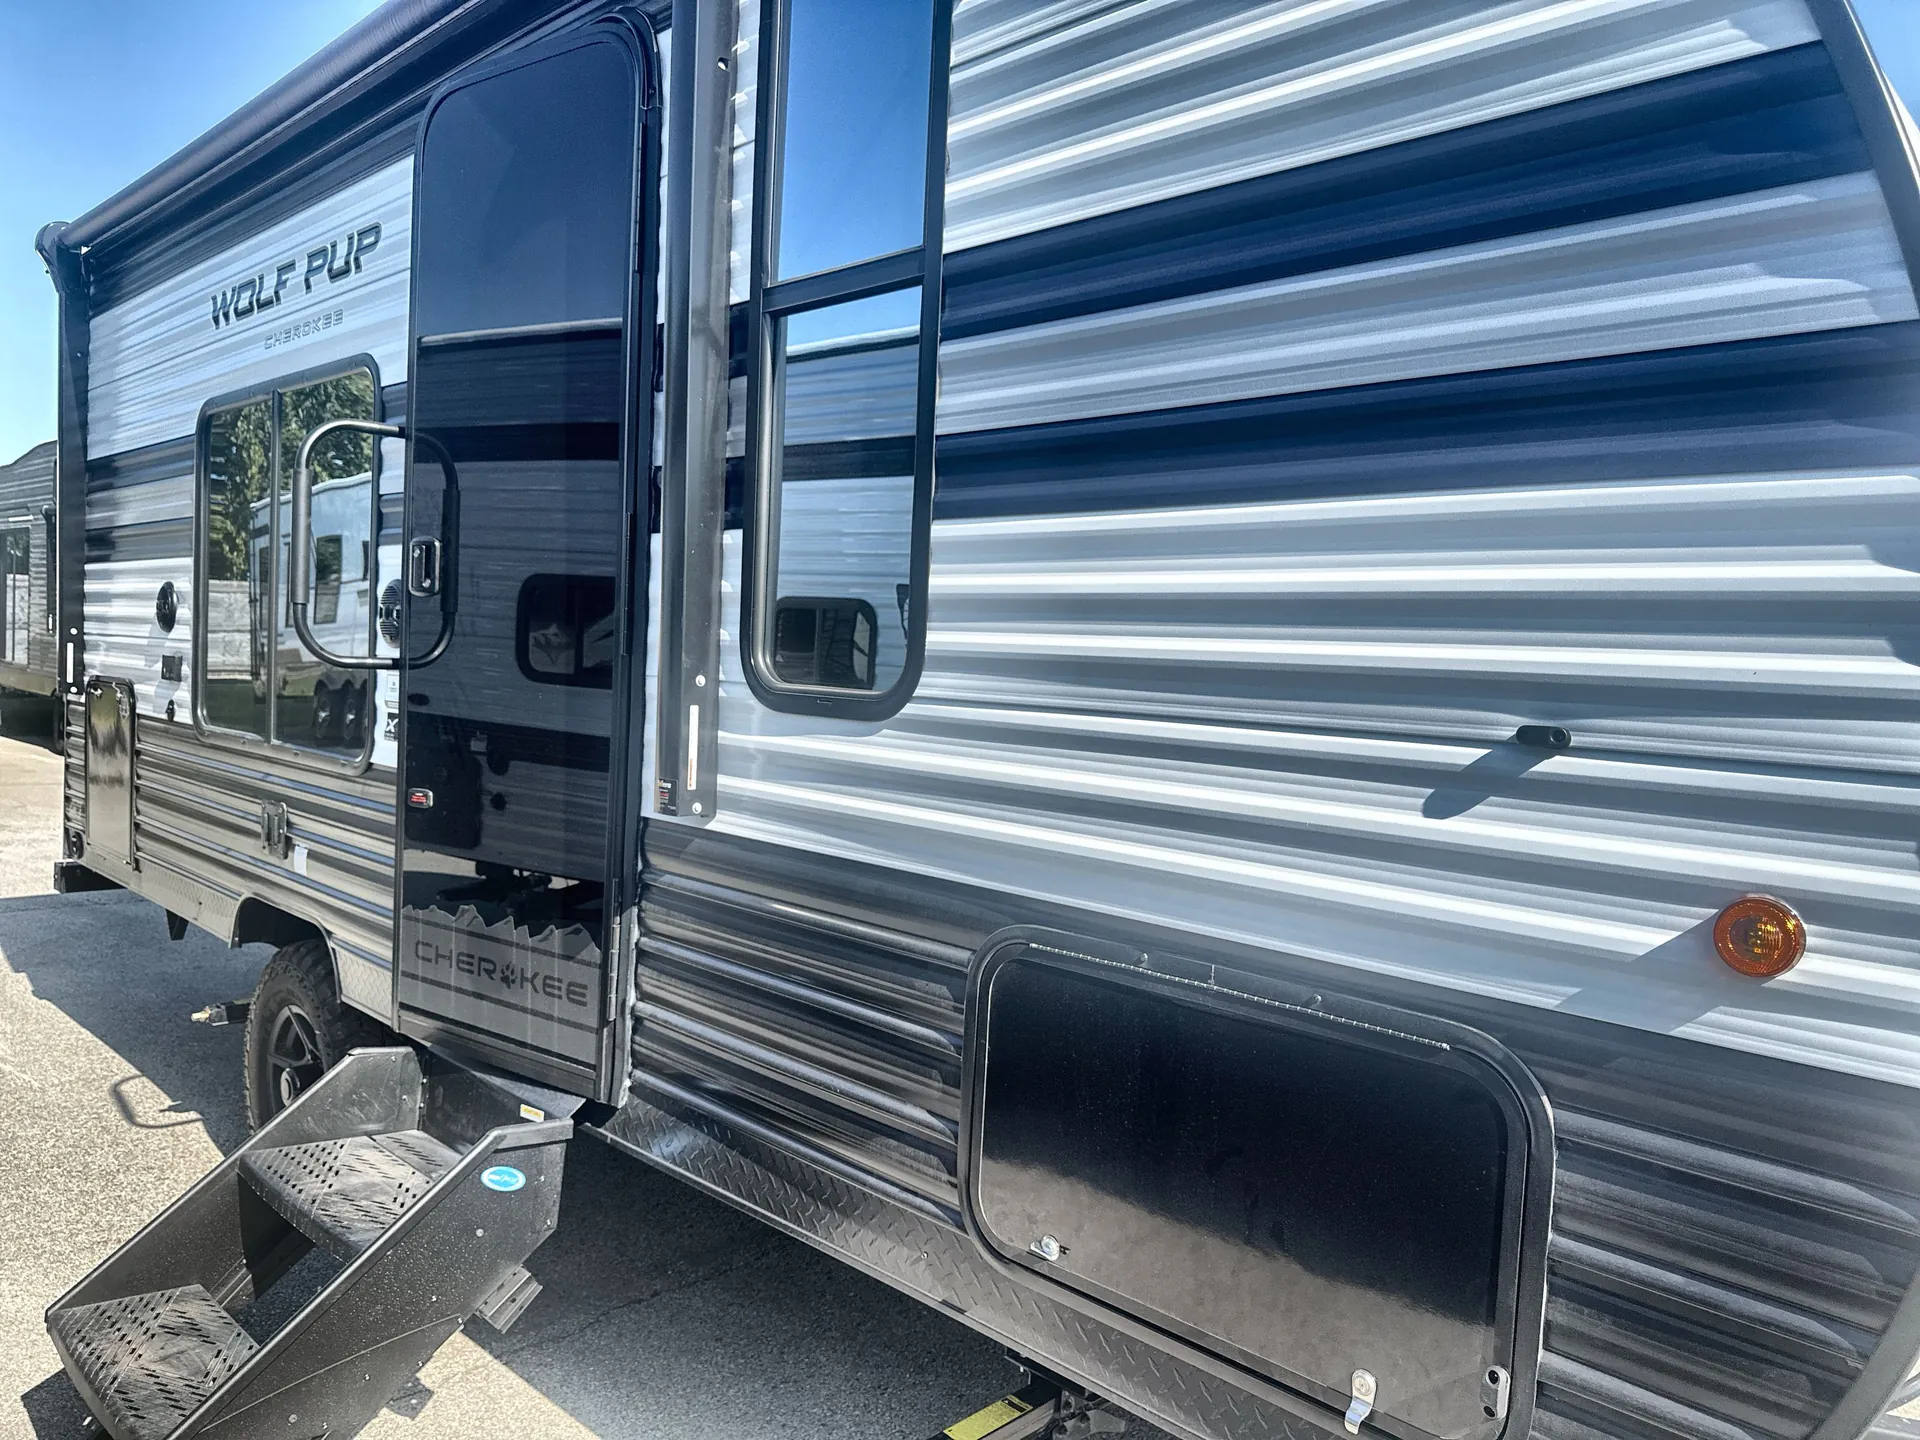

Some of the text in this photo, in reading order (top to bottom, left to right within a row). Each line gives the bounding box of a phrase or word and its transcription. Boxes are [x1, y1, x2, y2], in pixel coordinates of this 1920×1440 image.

[210, 221, 382, 330] WOLF PUP
[264, 308, 344, 350] CHEROKEE
